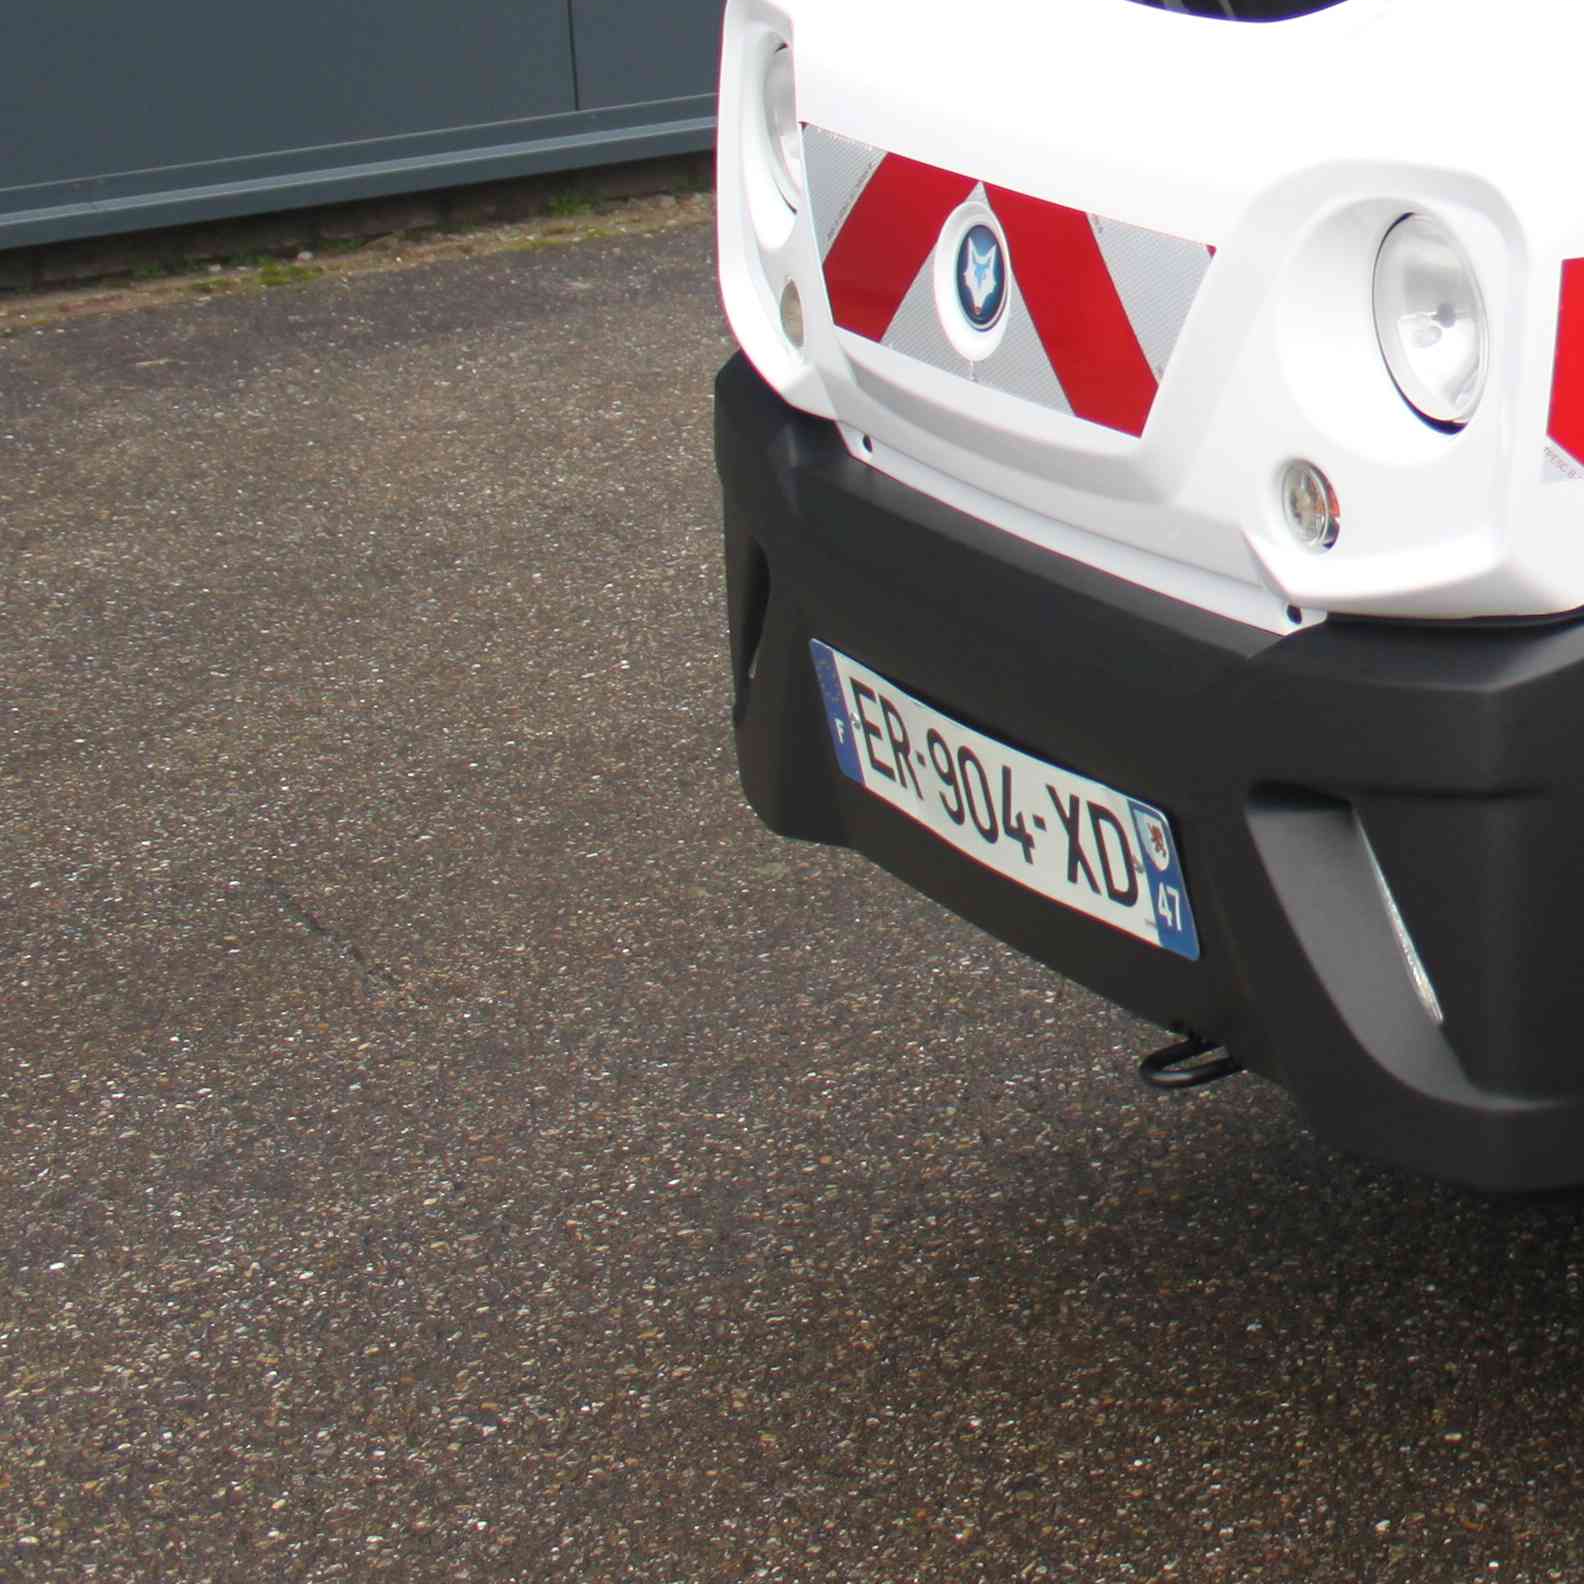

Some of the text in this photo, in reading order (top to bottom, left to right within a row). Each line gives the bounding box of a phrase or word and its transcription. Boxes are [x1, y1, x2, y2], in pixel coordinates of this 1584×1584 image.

[833, 718, 846, 744] F
[850, 676, 1139, 908] ER-904-XD
[1156, 884, 1183, 932] 47
